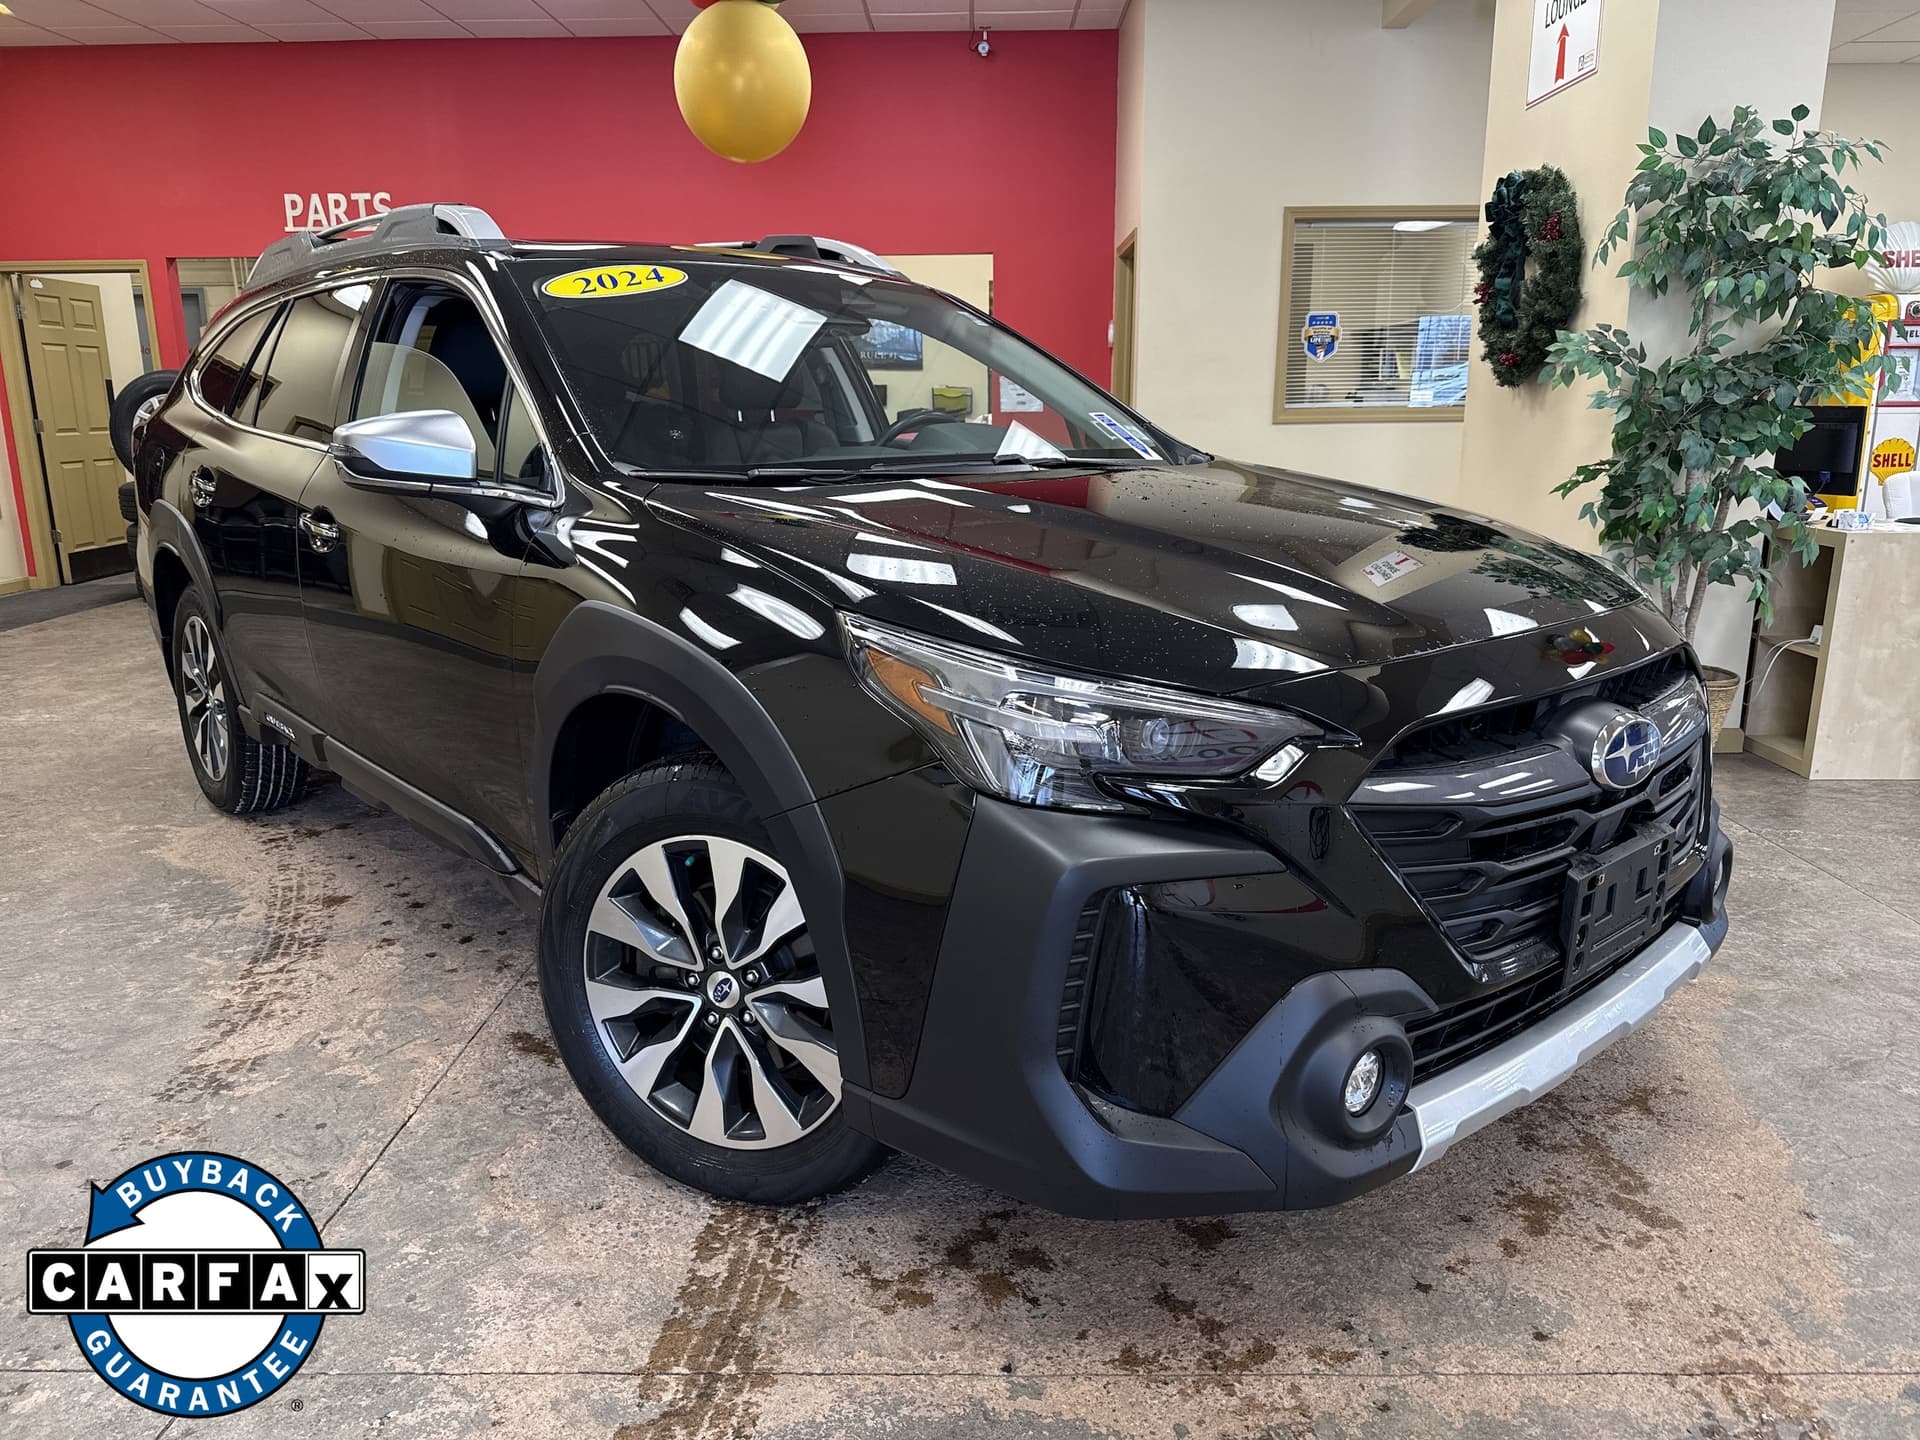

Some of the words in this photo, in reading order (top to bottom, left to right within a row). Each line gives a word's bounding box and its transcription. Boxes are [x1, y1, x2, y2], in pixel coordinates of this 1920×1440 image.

[1545, 0, 1587, 29] LOUN
[283, 191, 392, 229] PARTS
[573, 267, 665, 295] 2024
[1872, 453, 1912, 468] SHELL
